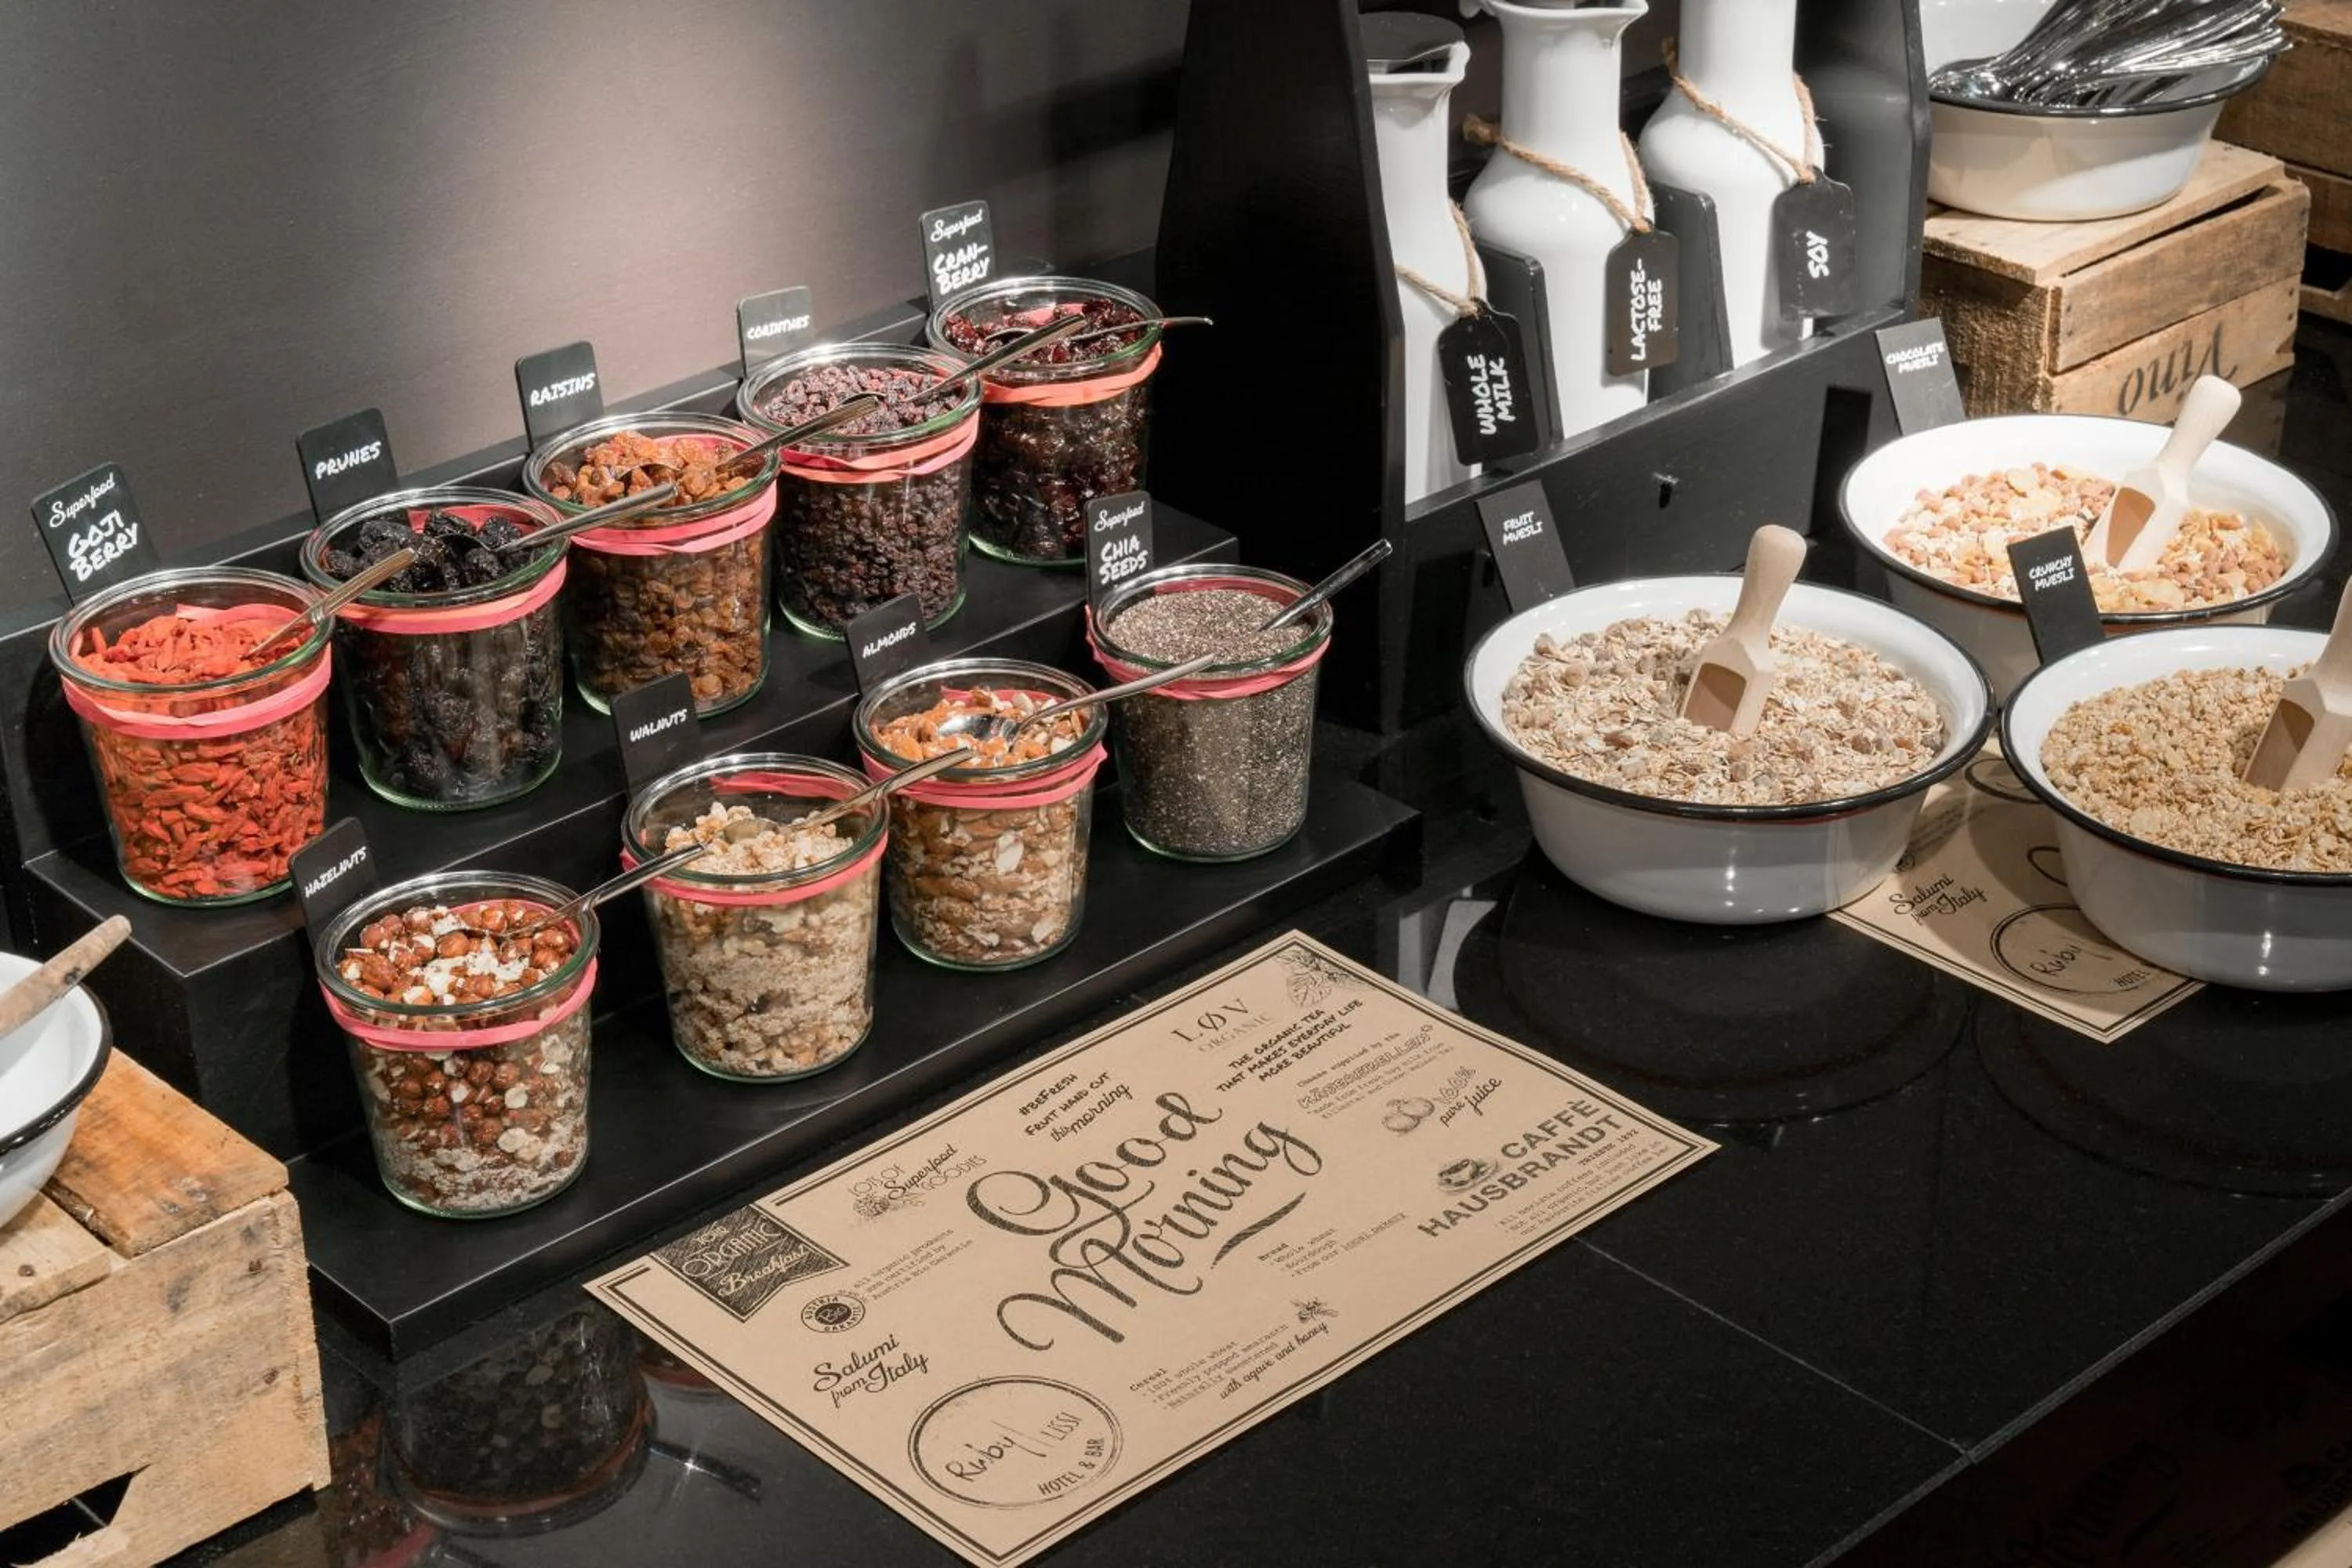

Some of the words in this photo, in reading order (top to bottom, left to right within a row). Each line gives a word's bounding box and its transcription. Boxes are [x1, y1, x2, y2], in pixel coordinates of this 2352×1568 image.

[930, 208, 983, 241] Superfood
[933, 242, 988, 274] CRAN-
[935, 256, 990, 295] BERRY
[1806, 230, 1830, 279] SOY
[1631, 257, 1646, 361] LACTOSE-
[1647, 278, 1662, 332] FREE
[530, 372, 596, 407] RAISINS
[1467, 354, 1497, 435] WHOLE
[1489, 357, 1515, 421] MILK
[315, 441, 382, 480] PRUNES
[49, 471, 115, 528] Superfood
[1094, 501, 1145, 532] Superfood
[1503, 511, 1534, 532] FRUIT
[68, 510, 124, 558] GOJI
[69, 523, 138, 582] BERRY
[1101, 534, 1141, 563] CHIA
[1502, 521, 1543, 546] MUESLI
[1098, 550, 1149, 586] SEEDS
[2028, 555, 2073, 580] CRUNCHY
[2034, 567, 2075, 591] MUESLI
[862, 622, 916, 659] ALMONDS
[630, 709, 688, 742] WALNUTS
[304, 846, 367, 898] HAZELNUTS
[1889, 873, 1955, 915] Salumi
[1936, 887, 1987, 915] Italy
[1171, 998, 1249, 1042] LØV
[1228, 1053, 1254, 1069] THE
[1254, 1023, 1303, 1054] ORGANIC
[1300, 1009, 1326, 1023] TEA
[1216, 1072, 1246, 1092] THAT
[1247, 1045, 1288, 1073] MAKES
[1287, 1014, 1337, 1048] EVERYDAY
[1337, 999, 1363, 1017] LIFE
[1258, 1058, 1294, 1082] MORE
[1290, 1023, 1352, 1060] BEAUTIFUL
[1024, 1109, 1059, 1136] FRUIT
[1058, 1089, 1089, 1112] HAND
[1089, 1072, 1110, 1090] CUT
[1070, 1083, 1134, 1134] morning
[1439, 1102, 1465, 1128] pure
[1464, 1078, 1503, 1116] juice
[1501, 1099, 1601, 1159] CAFFÈ
[884, 1143, 958, 1200] Superfood
[966, 1092, 1222, 1268] Good
[1417, 1114, 1622, 1238] HAUSBRANDT
[683, 1222, 782, 1278] ORGANIC
[996, 1121, 1322, 1350] Morning
[720, 1246, 807, 1294] Breakfast
[814, 1334, 899, 1392] Salumi
[831, 1378, 867, 1408] from
[866, 1352, 928, 1392] Italy
[1220, 1377, 1243, 1400] with
[1243, 1359, 1276, 1382] agave
[1274, 1341, 1297, 1361] and
[1294, 1322, 1329, 1346] honey
[945, 1436, 1047, 1483] Ruby
[1040, 1411, 1083, 1442] LISSI
[1078, 1461, 1097, 1470] &
[1084, 1437, 1105, 1457] BAR
[1037, 1471, 1085, 1496] HOTEL
